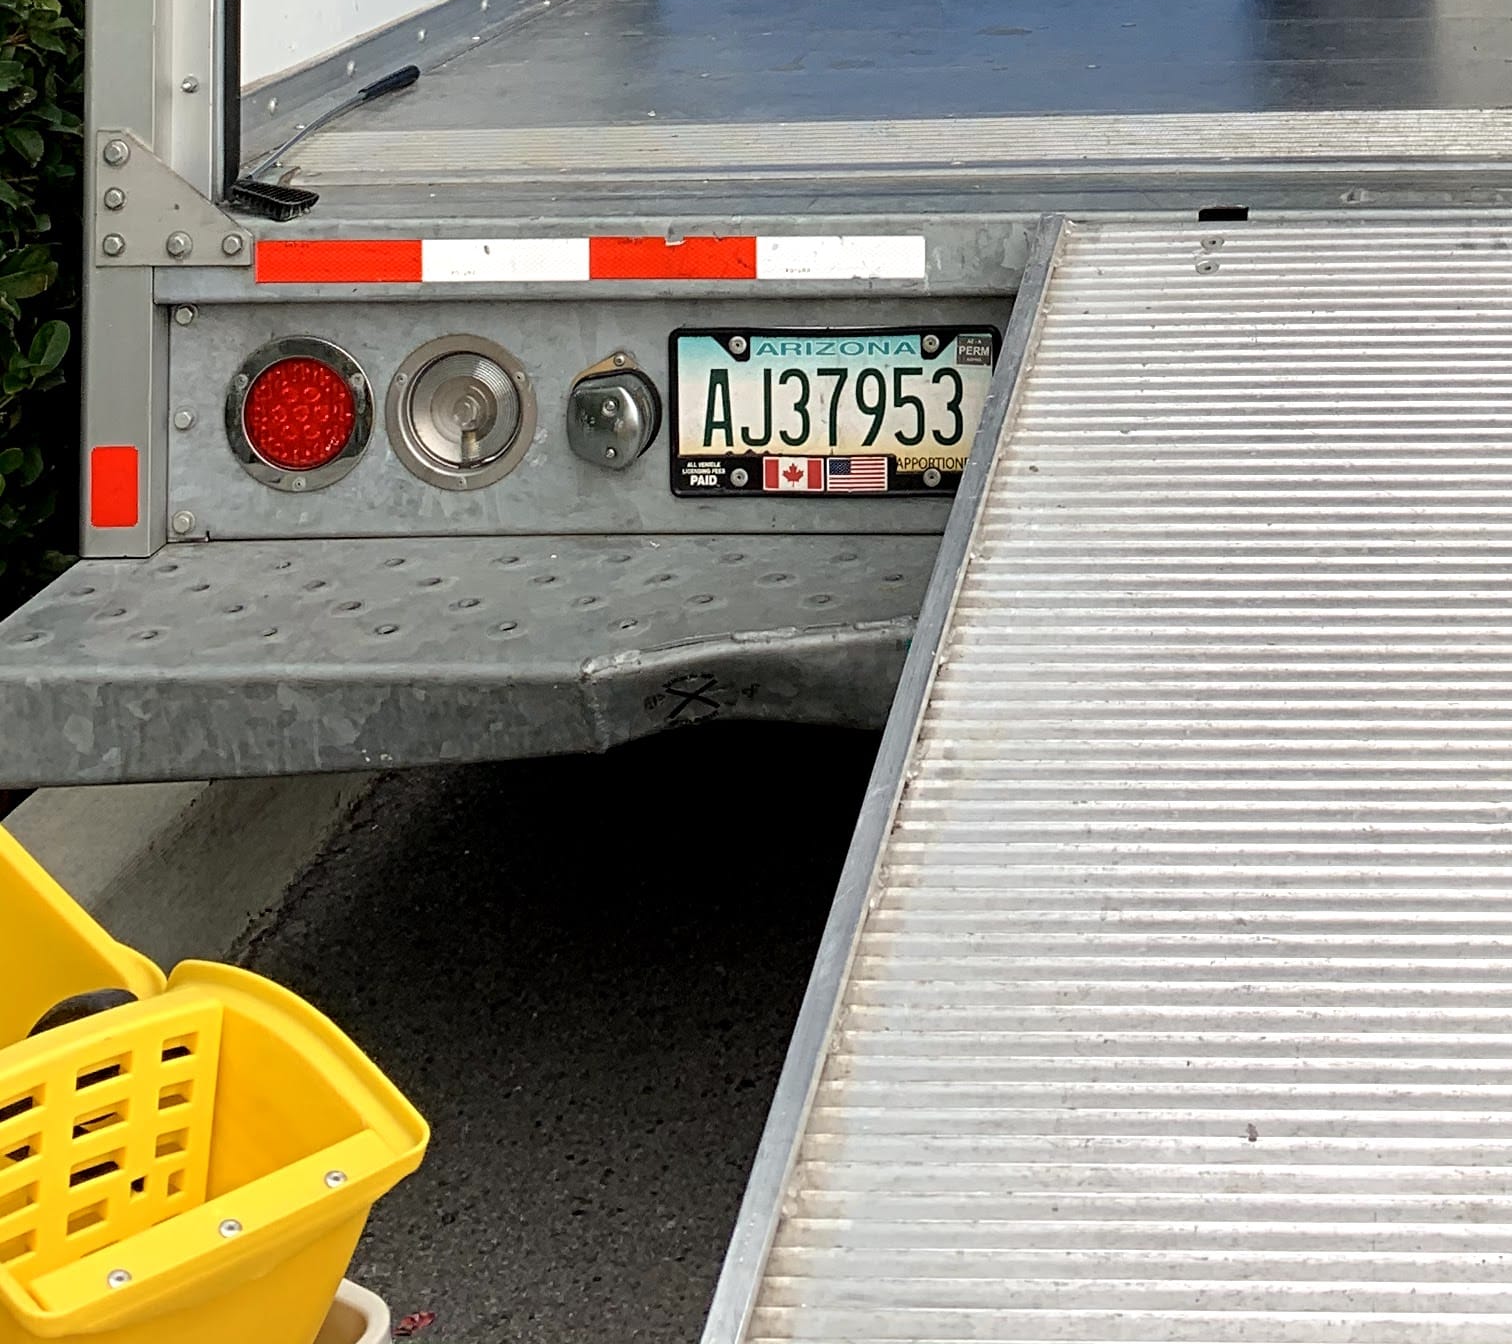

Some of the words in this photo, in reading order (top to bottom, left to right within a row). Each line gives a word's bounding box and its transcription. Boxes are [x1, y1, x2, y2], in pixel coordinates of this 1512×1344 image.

[755, 340, 917, 357] ARIZONA
[959, 345, 990, 356] PERM
[703, 367, 964, 448] AJ37953
[690, 474, 718, 486] PAID
